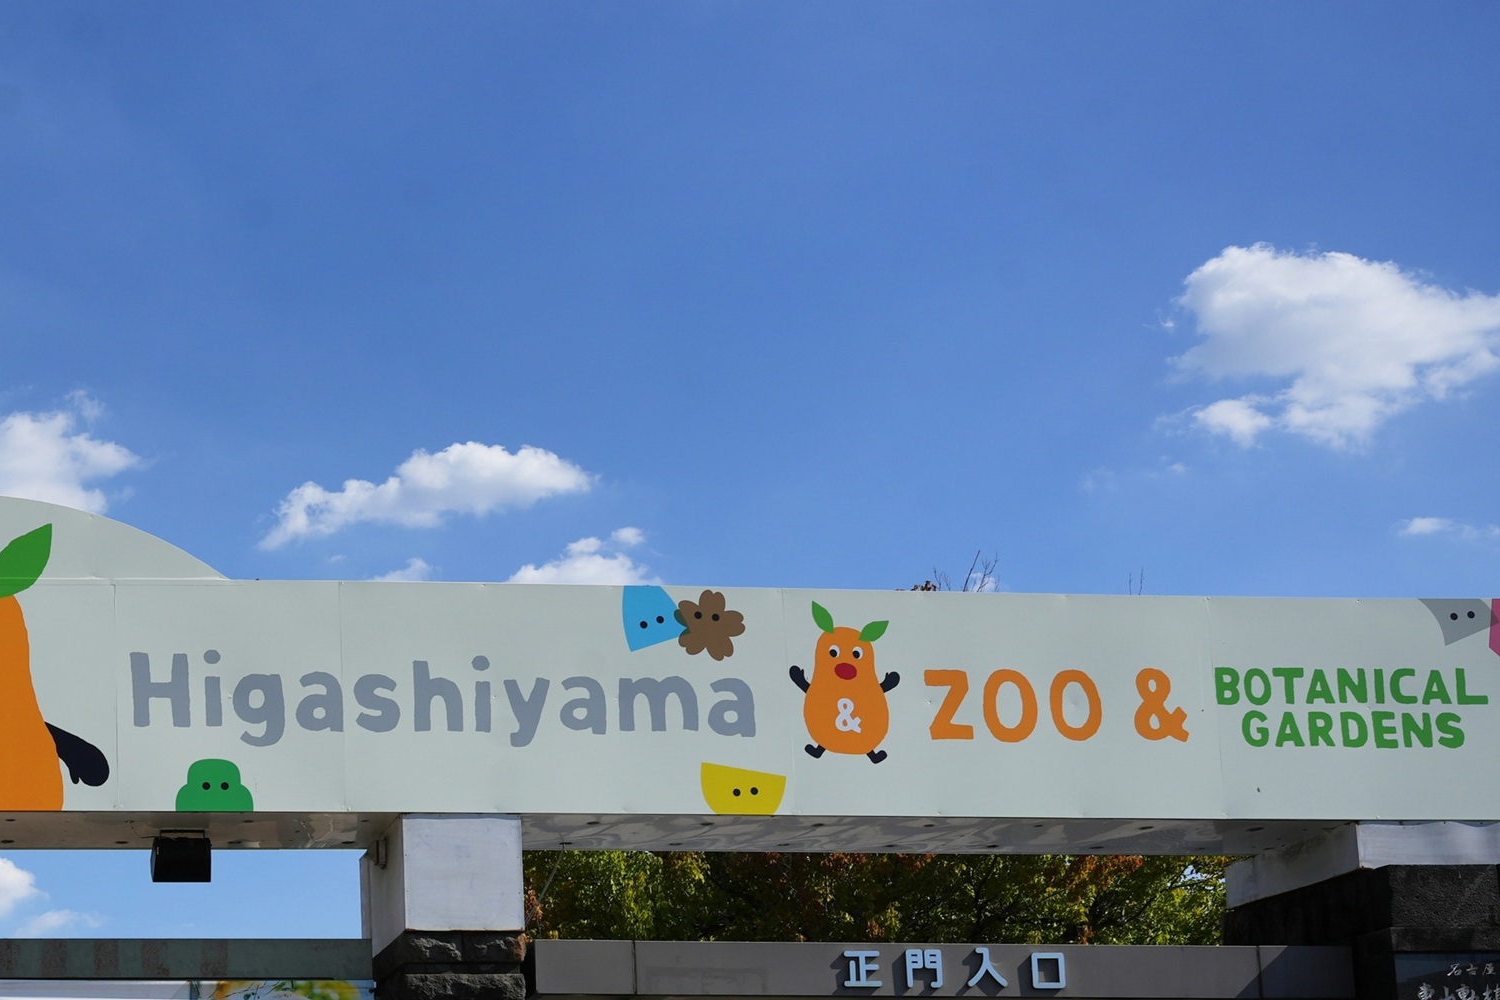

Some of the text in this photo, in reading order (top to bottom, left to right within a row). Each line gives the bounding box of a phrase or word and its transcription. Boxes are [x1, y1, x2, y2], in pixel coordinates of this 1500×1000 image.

[130, 650, 756, 747] Higashiyama
[923, 668, 1189, 743] ZOO &
[1214, 667, 1488, 707] BOTANICAL
[835, 697, 862, 734] &
[1241, 710, 1465, 749] GARDENS
[843, 947, 1067, 989] 正門入口
[1447, 963, 1497, 977] 名古屋
